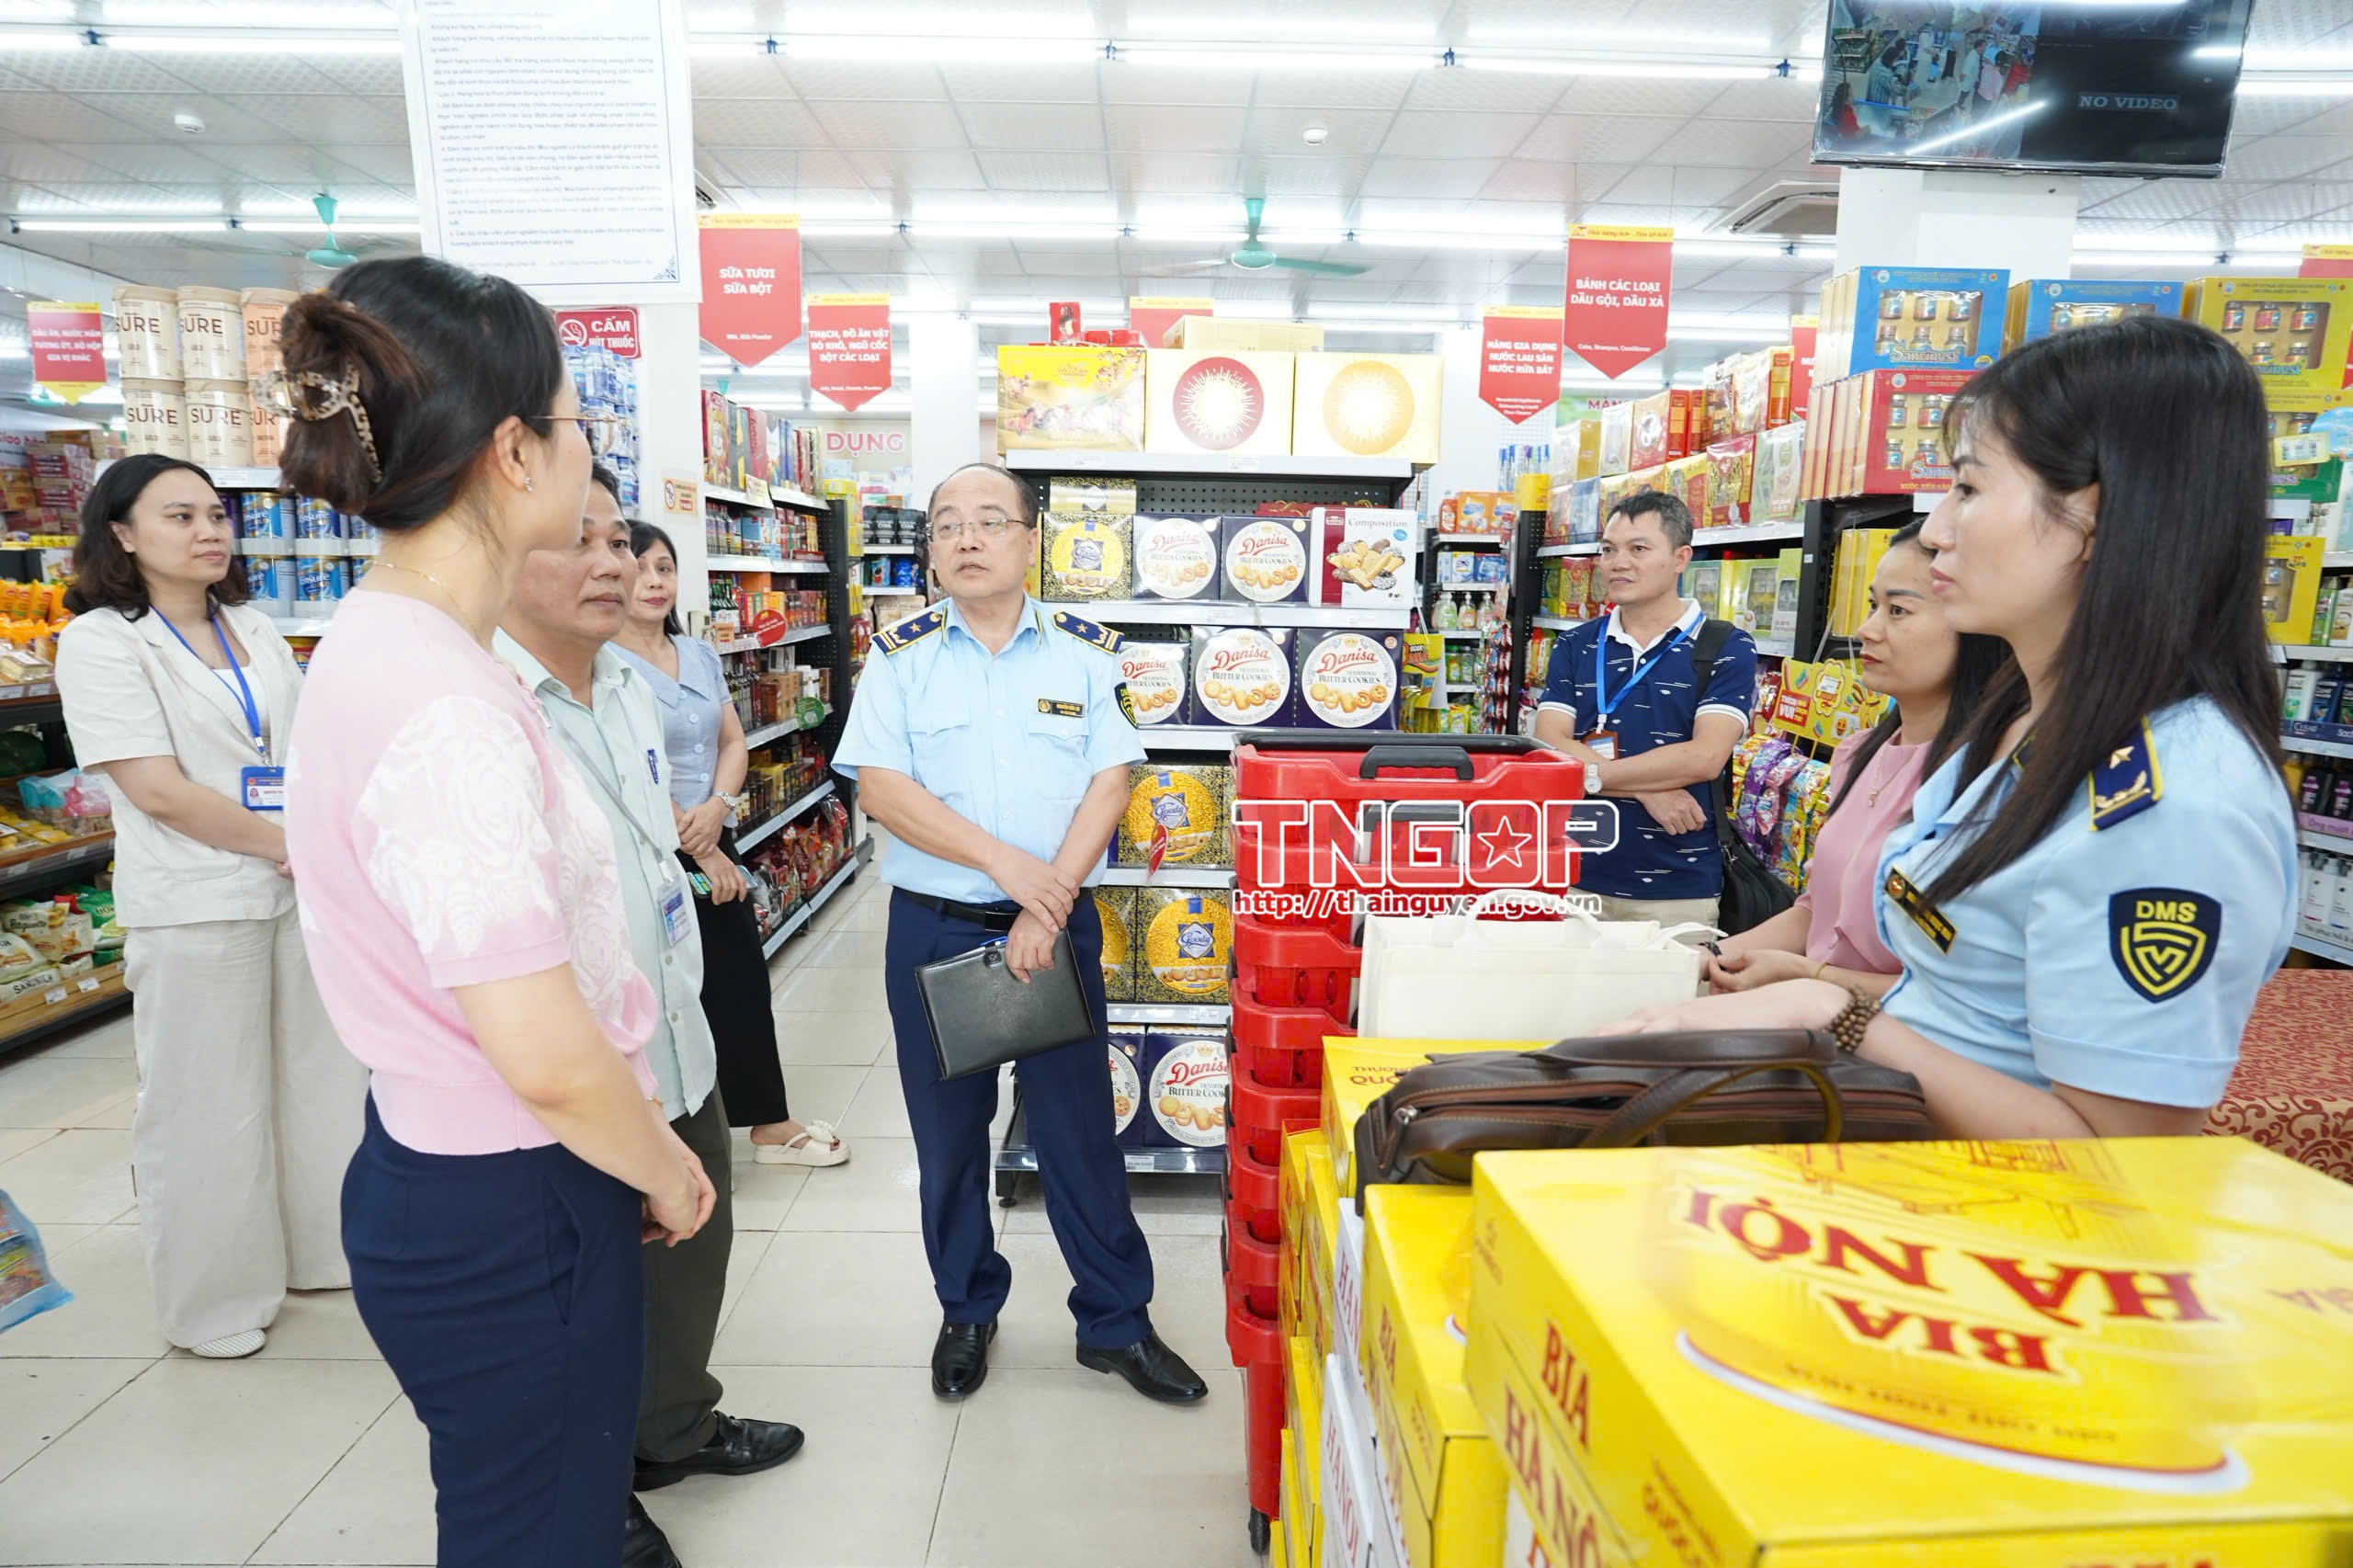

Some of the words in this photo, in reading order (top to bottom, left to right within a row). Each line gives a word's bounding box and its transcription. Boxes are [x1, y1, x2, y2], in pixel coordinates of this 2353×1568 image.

[2078, 95, 2108, 108] NO
[2115, 97, 2177, 109] VIDEO
[720, 266, 744, 278] SỮA
[745, 267, 775, 278] TƯƠI
[723, 281, 747, 294] SỮA
[750, 282, 772, 296] BỘT
[1608, 278, 1631, 290] CÁC
[1633, 281, 1661, 294] LOẠI
[1571, 291, 1594, 304] DẦU
[1596, 293, 1620, 308] GỘI,
[1623, 294, 1646, 307] DẦU
[1648, 295, 1664, 307] XẢ
[116, 316, 161, 334] SURE
[246, 320, 281, 336] SUR
[591, 316, 631, 333] CẤM
[589, 335, 607, 348] HÚT
[608, 333, 635, 348] THUỐC
[809, 329, 841, 340] THẠCH,
[843, 328, 857, 337] ĐỒ
[858, 328, 870, 337] ĂN
[871, 328, 890, 339] VẬT
[870, 339, 889, 349] CỐC
[1486, 339, 1512, 349] HÀNG
[1514, 341, 1530, 349] GIA
[1531, 342, 1558, 352] DỤNG
[820, 352, 837, 363] BỘT
[839, 352, 857, 361] CÁC
[858, 353, 881, 363] LOẠI
[1489, 351, 1516, 361] NƯỚC
[1517, 353, 1534, 362] LAU
[1535, 353, 1553, 362] SÀN
[1488, 363, 1515, 372] NƯỚC
[1516, 364, 1534, 374] RỬA
[1536, 365, 1553, 374] BÁT
[1587, 395, 1627, 411] MÀN
[128, 407, 177, 425] SURE
[191, 408, 242, 426] SURE
[826, 432, 904, 456] DỤNG
[1347, 518, 1407, 529] Composition
[1150, 530, 1201, 552] Danisa
[1238, 533, 1290, 556] Danisa
[1211, 643, 1272, 671] Danisa
[1316, 647, 1379, 675] Danisa
[1122, 657, 1169, 679] Danisa
[1212, 671, 1240, 680] BUTTER
[1241, 673, 1273, 681] COOKIES
[1319, 674, 1347, 683] BUTTER
[1347, 676, 1381, 684] COOKIES
[1779, 704, 1796, 720] VUI
[2294, 722, 2318, 733] CLEAR
[1154, 801, 1184, 821] Goody
[2135, 899, 2198, 925] DMS
[1180, 930, 1211, 949] Goody
[13, 974, 53, 994] SANDWICH
[1168, 1086, 1201, 1097] BUTTER
[1202, 1088, 1226, 1098] COOK
[1814, 1290, 2067, 1375] BIA
[1541, 1321, 1590, 1452] BIA
[1326, 1412, 1359, 1568] HANOI
